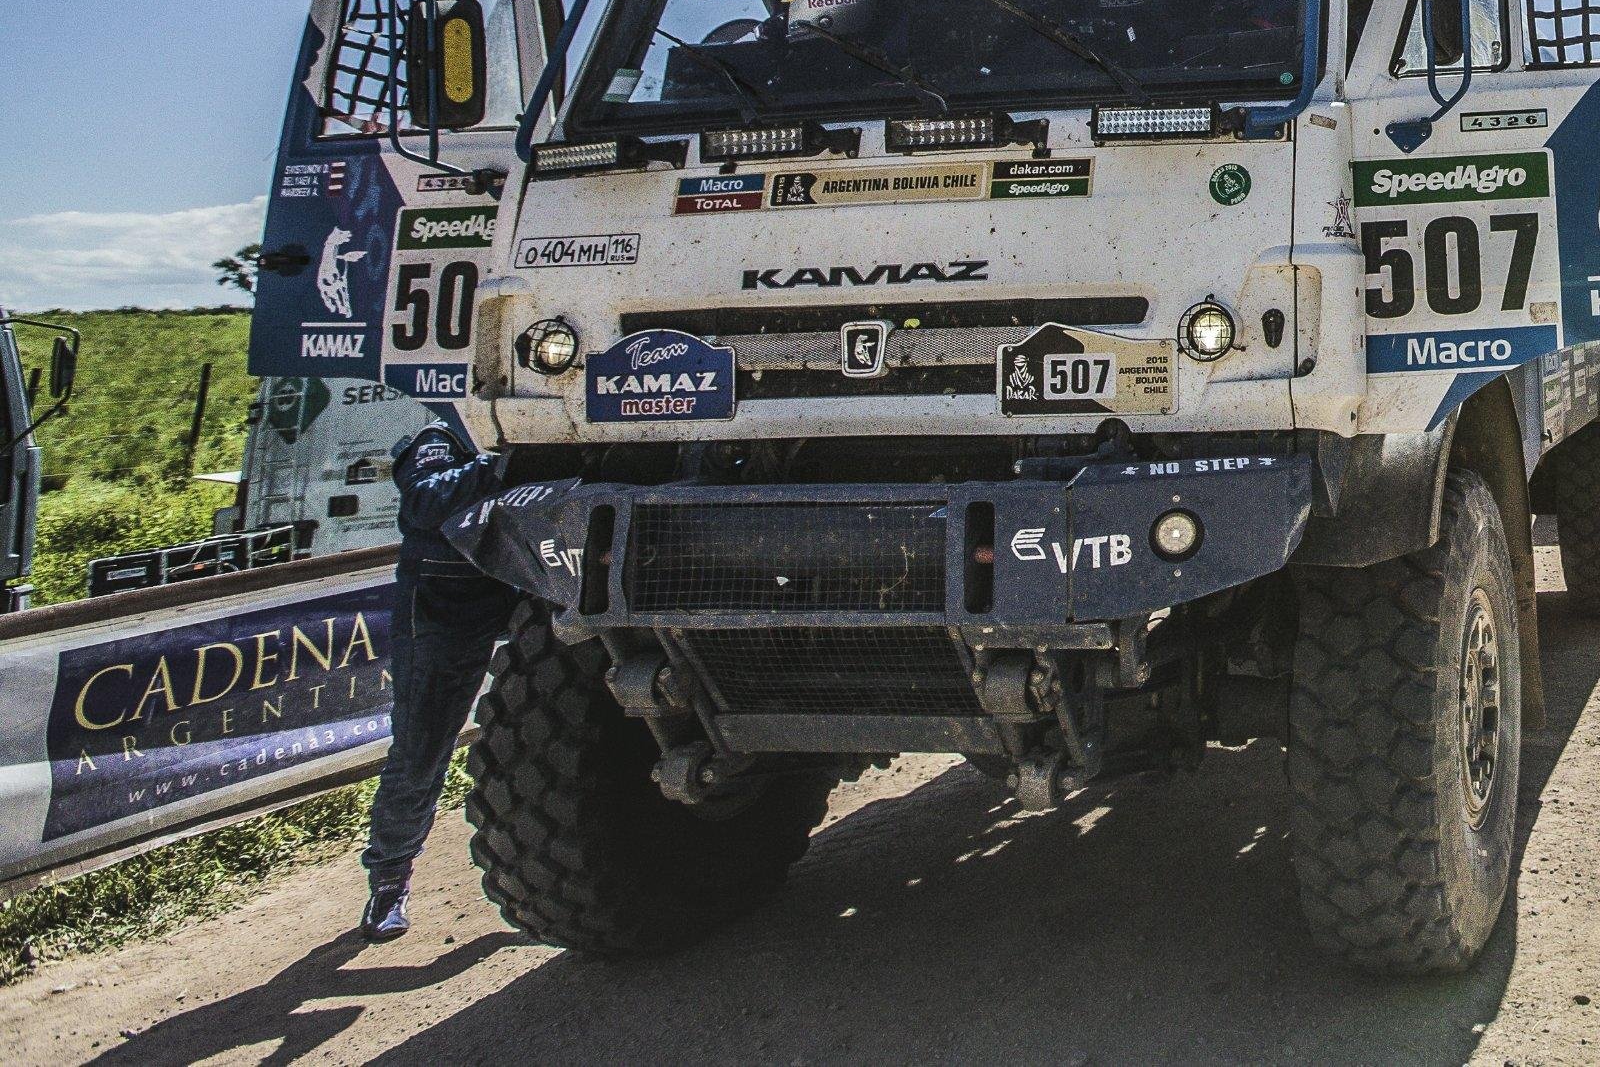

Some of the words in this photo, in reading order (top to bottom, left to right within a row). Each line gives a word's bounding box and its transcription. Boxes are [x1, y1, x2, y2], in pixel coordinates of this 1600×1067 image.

[1009, 164, 1074, 175] dakar.com
[1370, 164, 1527, 198] SpeedAgro
[700, 179, 744, 193] Macro
[822, 179, 890, 194] ARGENTINA
[892, 176, 939, 191] BOLIVIA
[943, 174, 977, 188] CHILE
[1008, 183, 1070, 195] SpeedAgro
[612, 238, 633, 253] 116
[741, 260, 990, 290] KAMAZ
[1361, 213, 1540, 320] 507
[392, 261, 479, 351] 50
[301, 334, 365, 358] KAMAZ
[626, 336, 688, 371] Team
[1406, 336, 1512, 366] Macro
[1118, 366, 1168, 375] ARGENTINA
[1145, 356, 1168, 365] 2015
[416, 370, 466, 393] Mac
[597, 370, 718, 396] KAMAZ
[1050, 359, 1111, 394] 507
[1135, 376, 1168, 385] BOLIVIA
[1143, 386, 1168, 394] CHILE
[621, 396, 697, 415] master
[1149, 461, 1180, 476] NO
[1195, 457, 1250, 472] STEP
[560, 548, 584, 577] VT
[1051, 533, 1132, 574] VTB
[75, 611, 379, 730] CADENA
[76, 669, 393, 774] ARGENTIN
